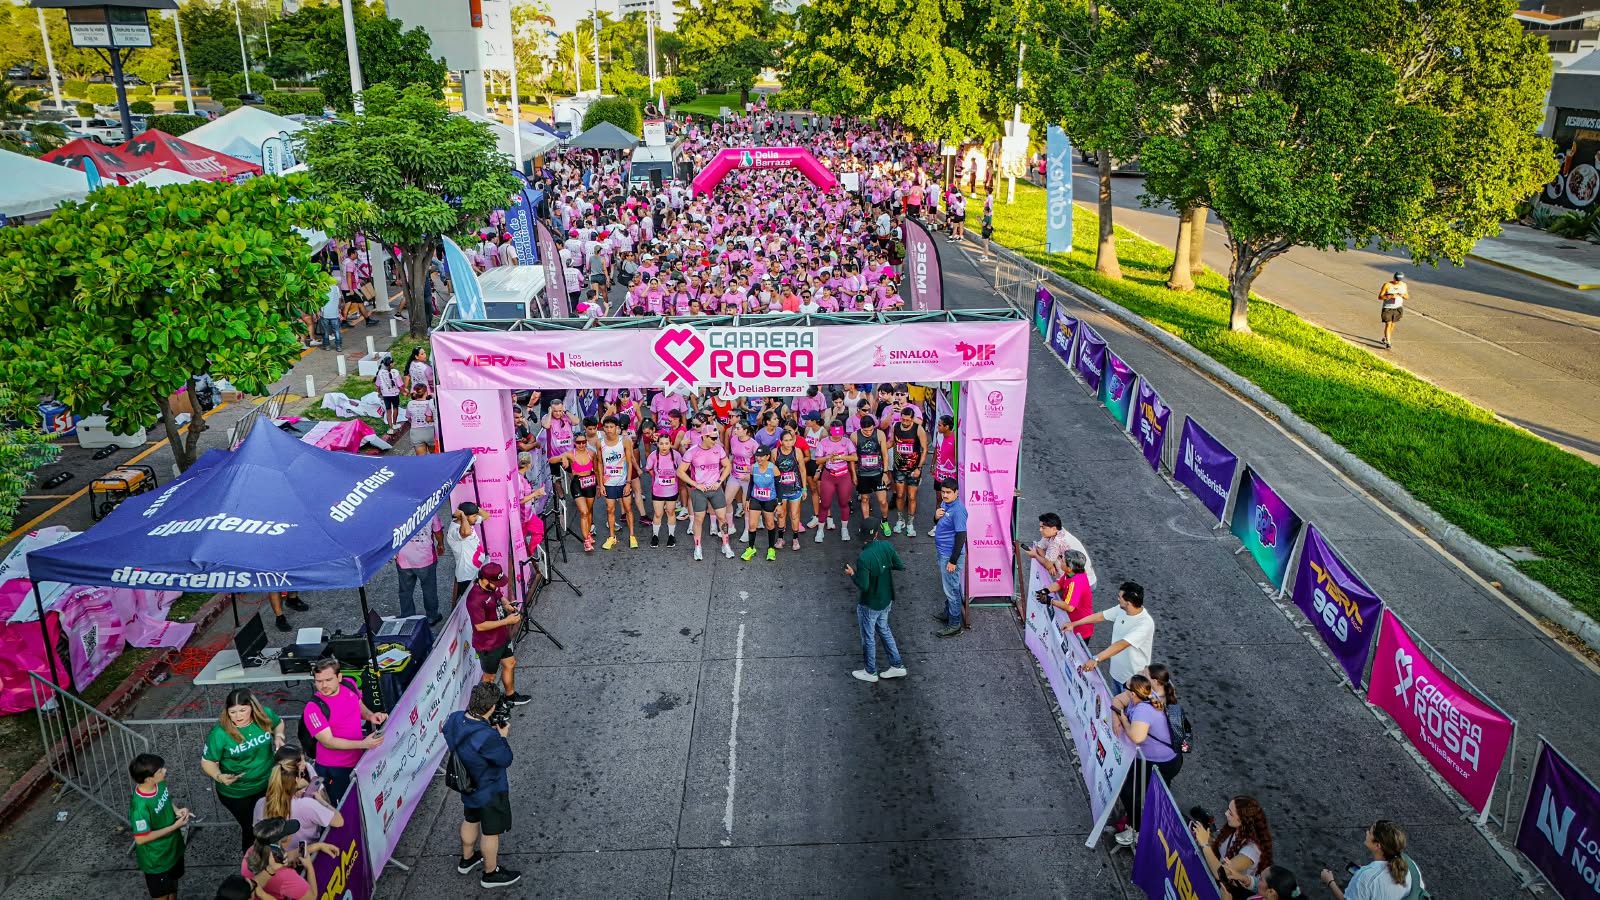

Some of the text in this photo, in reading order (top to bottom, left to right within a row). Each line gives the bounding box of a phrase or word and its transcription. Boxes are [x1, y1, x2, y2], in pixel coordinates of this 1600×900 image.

[755, 151, 779, 159] Delia
[755, 159, 791, 167] Barraza
[709, 331, 814, 348] CARRERA
[452, 354, 527, 367] VIBRA
[889, 350, 939, 359] SINALOA
[963, 344, 996, 361] DIF
[569, 360, 624, 368] Noticieristas
[710, 350, 814, 378] ROSA
[738, 385, 804, 393] DeliaBarraza
[972, 437, 1013, 446] VBRA
[1194, 449, 1202, 465] Los
[328, 466, 396, 523] dportenis
[391, 479, 454, 549] dportenis.mx
[148, 512, 292, 536] dportenis
[110, 565, 293, 588] dportenis.mx
[980, 568, 1002, 579] DIF
[1309, 560, 1364, 626] VIBRA
[1312, 587, 1349, 642] 96.9
[1415, 675, 1483, 744] CARRERA
[1413, 691, 1481, 772] ROSA
[1427, 736, 1470, 779] DeliaBarraza
